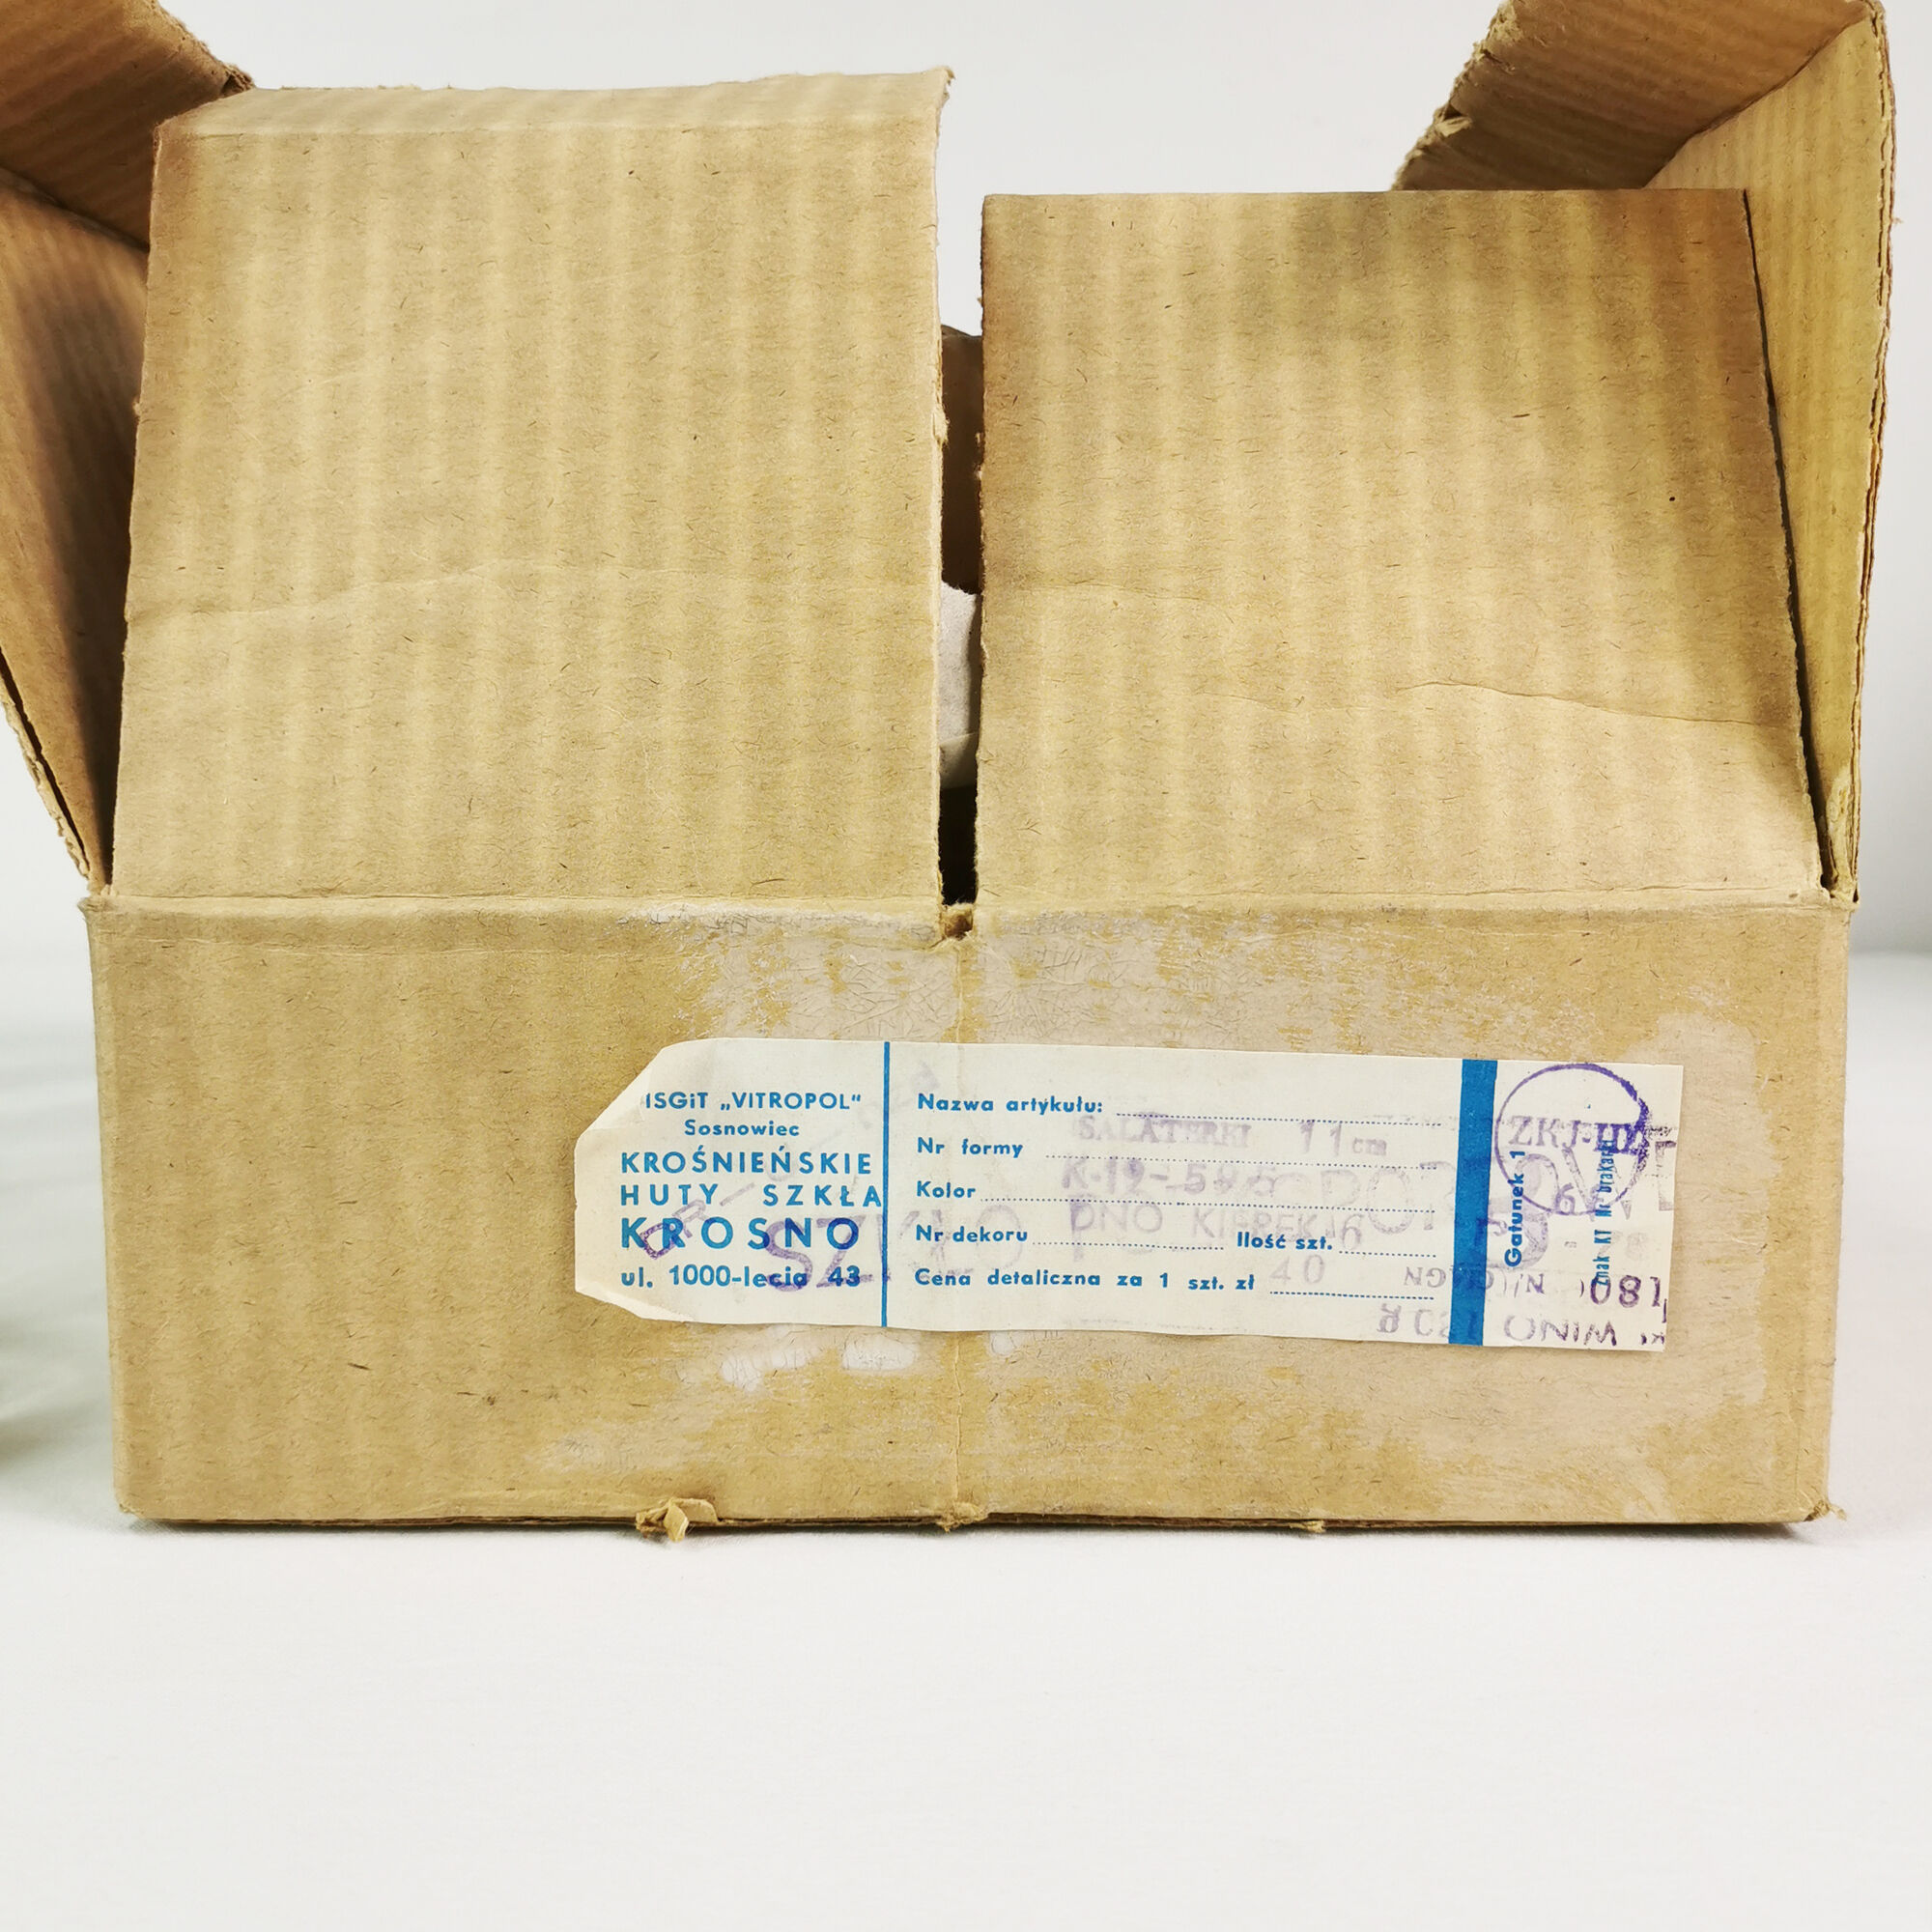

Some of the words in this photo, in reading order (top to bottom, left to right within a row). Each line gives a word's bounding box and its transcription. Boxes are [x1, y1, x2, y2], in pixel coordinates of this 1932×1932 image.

[917, 1093, 995, 1112] Nazwa
[1006, 1095, 1103, 1116] artykułu:
[683, 1119, 800, 1137] Sosnowiec
[917, 1136, 946, 1155] Nr
[961, 1138, 1024, 1158] formy
[1509, 1150, 1526, 1160] 1
[621, 1145, 871, 1175] KROŚNIEŃSKIE
[620, 1183, 719, 1207] HUTY
[762, 1183, 883, 1208] SZKŁA
[916, 1180, 977, 1199] Kolor
[1504, 1172, 1524, 1267] Gatunek
[621, 1217, 860, 1250] KROSNO
[916, 1225, 944, 1243] Nr
[952, 1225, 1029, 1243] dekoru
[1236, 1232, 1288, 1250] Ilość
[1594, 1229, 1612, 1244] KT
[621, 1265, 654, 1288] ul.
[668, 1264, 808, 1288] 1000-lecia
[827, 1264, 862, 1288] 43
[915, 1267, 972, 1287] Cena
[987, 1268, 1101, 1287] detaliczna
[1117, 1274, 1143, 1287] za
[1159, 1272, 1170, 1289] 1
[1236, 1273, 1256, 1291] zł
